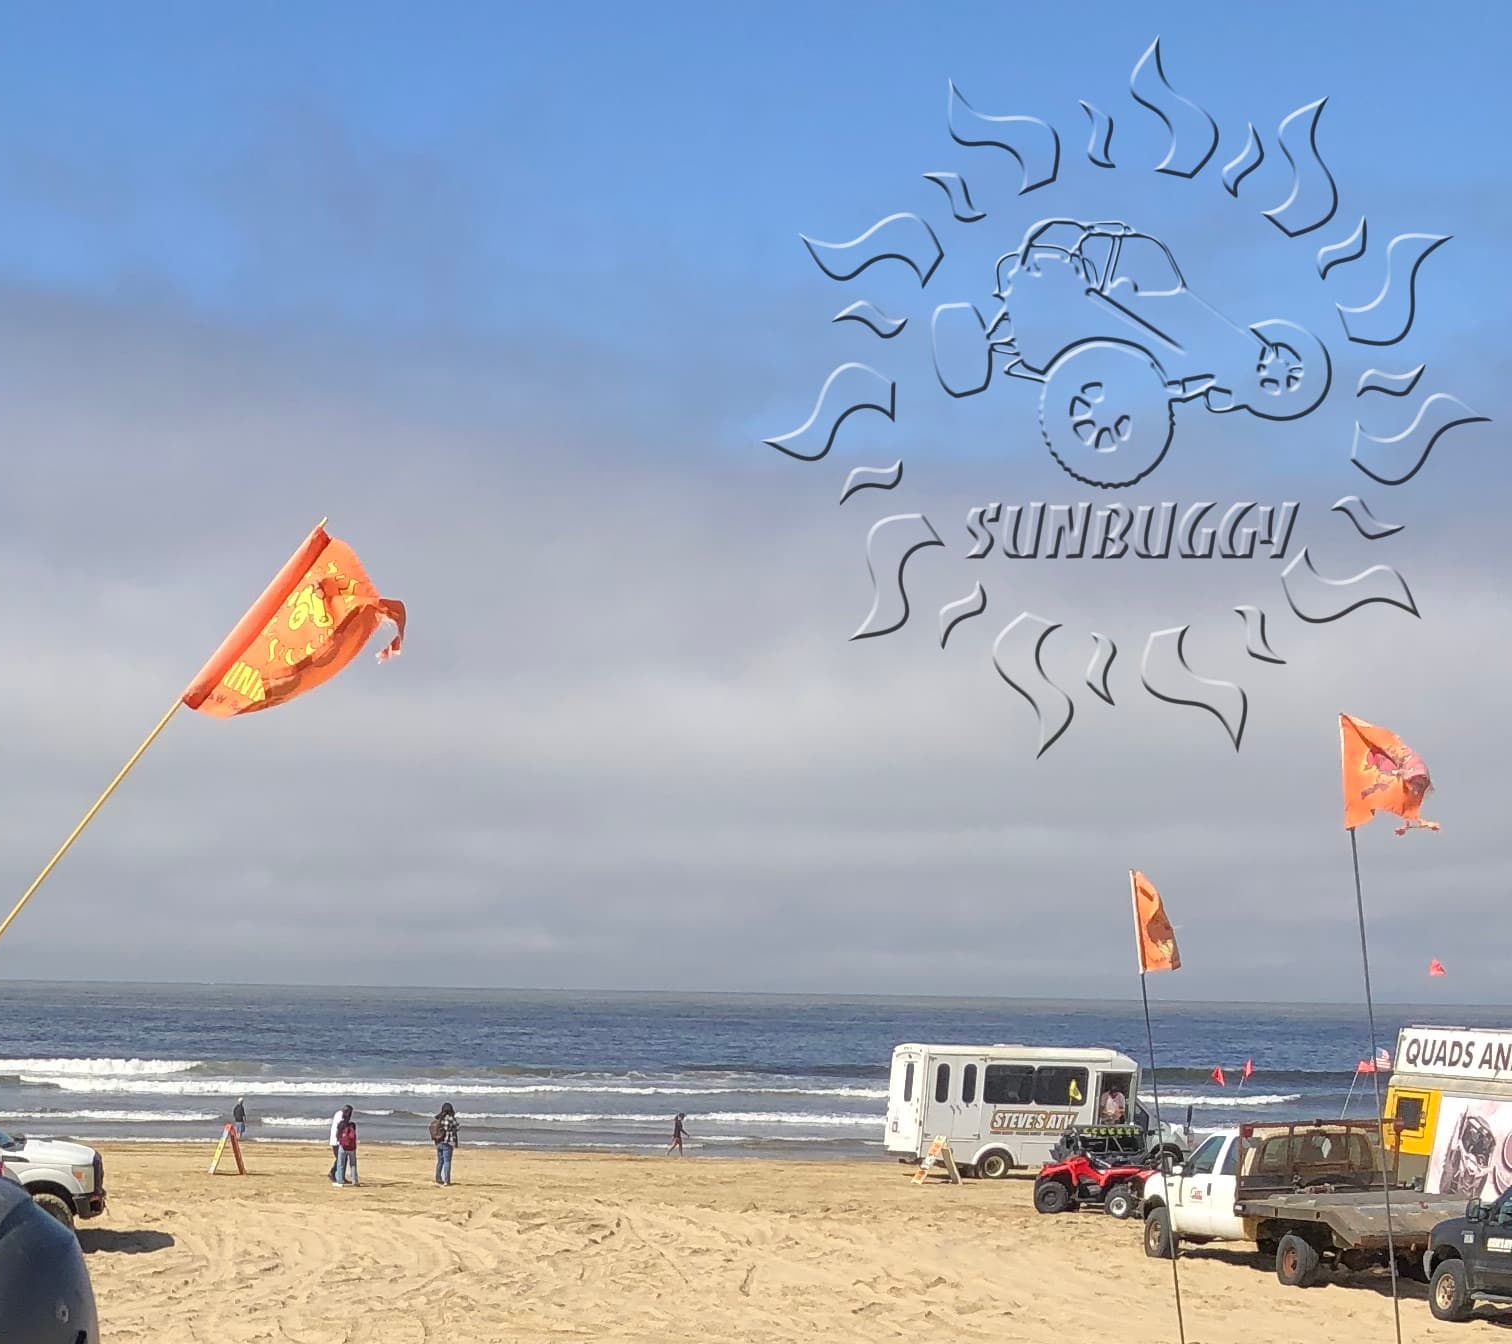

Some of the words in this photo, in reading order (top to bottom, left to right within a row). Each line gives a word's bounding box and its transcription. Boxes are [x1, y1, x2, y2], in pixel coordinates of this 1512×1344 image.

[1405, 1037, 1476, 1069] QUADS
[1478, 1042, 1512, 1072] AN
[992, 1112, 1046, 1129] STEVE'S
